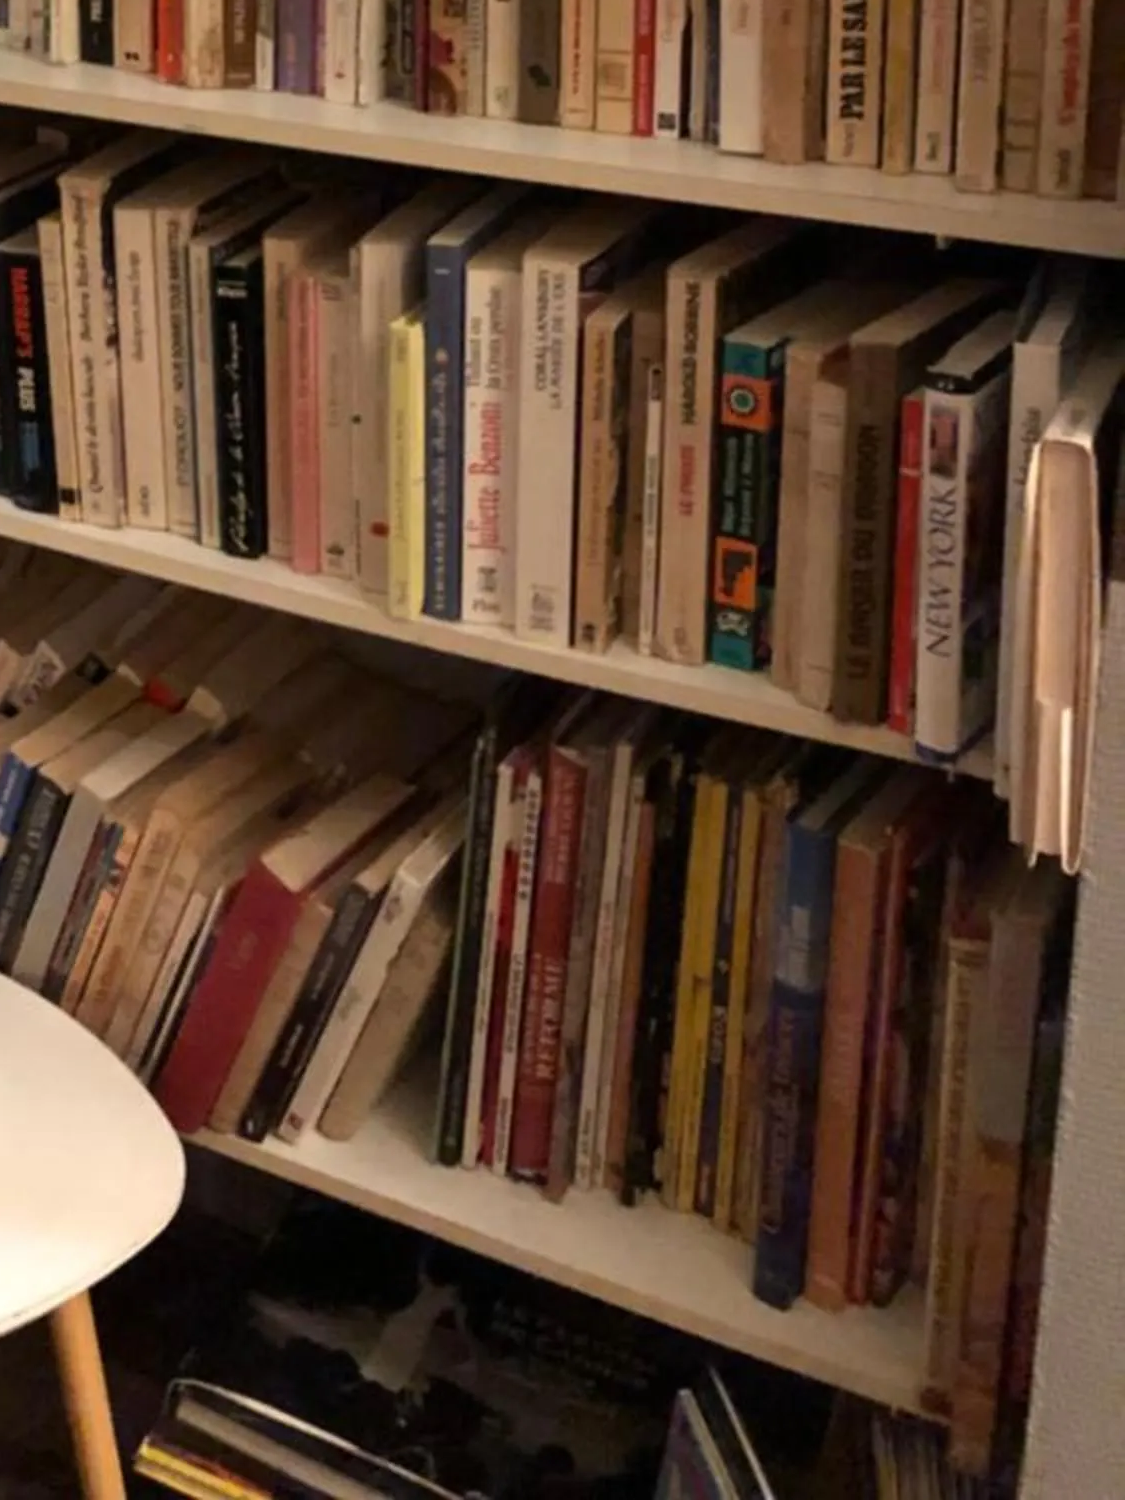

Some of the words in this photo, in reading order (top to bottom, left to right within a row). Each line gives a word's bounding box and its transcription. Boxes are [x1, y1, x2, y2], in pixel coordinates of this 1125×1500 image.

[841, 37, 867, 67] LE
[839, 72, 865, 122] PAR
[15, 365, 38, 414] PLUS
[681, 357, 698, 425] HAROLD
[468, 401, 503, 477] Benzoni
[467, 488, 508, 552] Juliette
[925, 485, 957, 572] YORK
[923, 579, 954, 659] NEW
